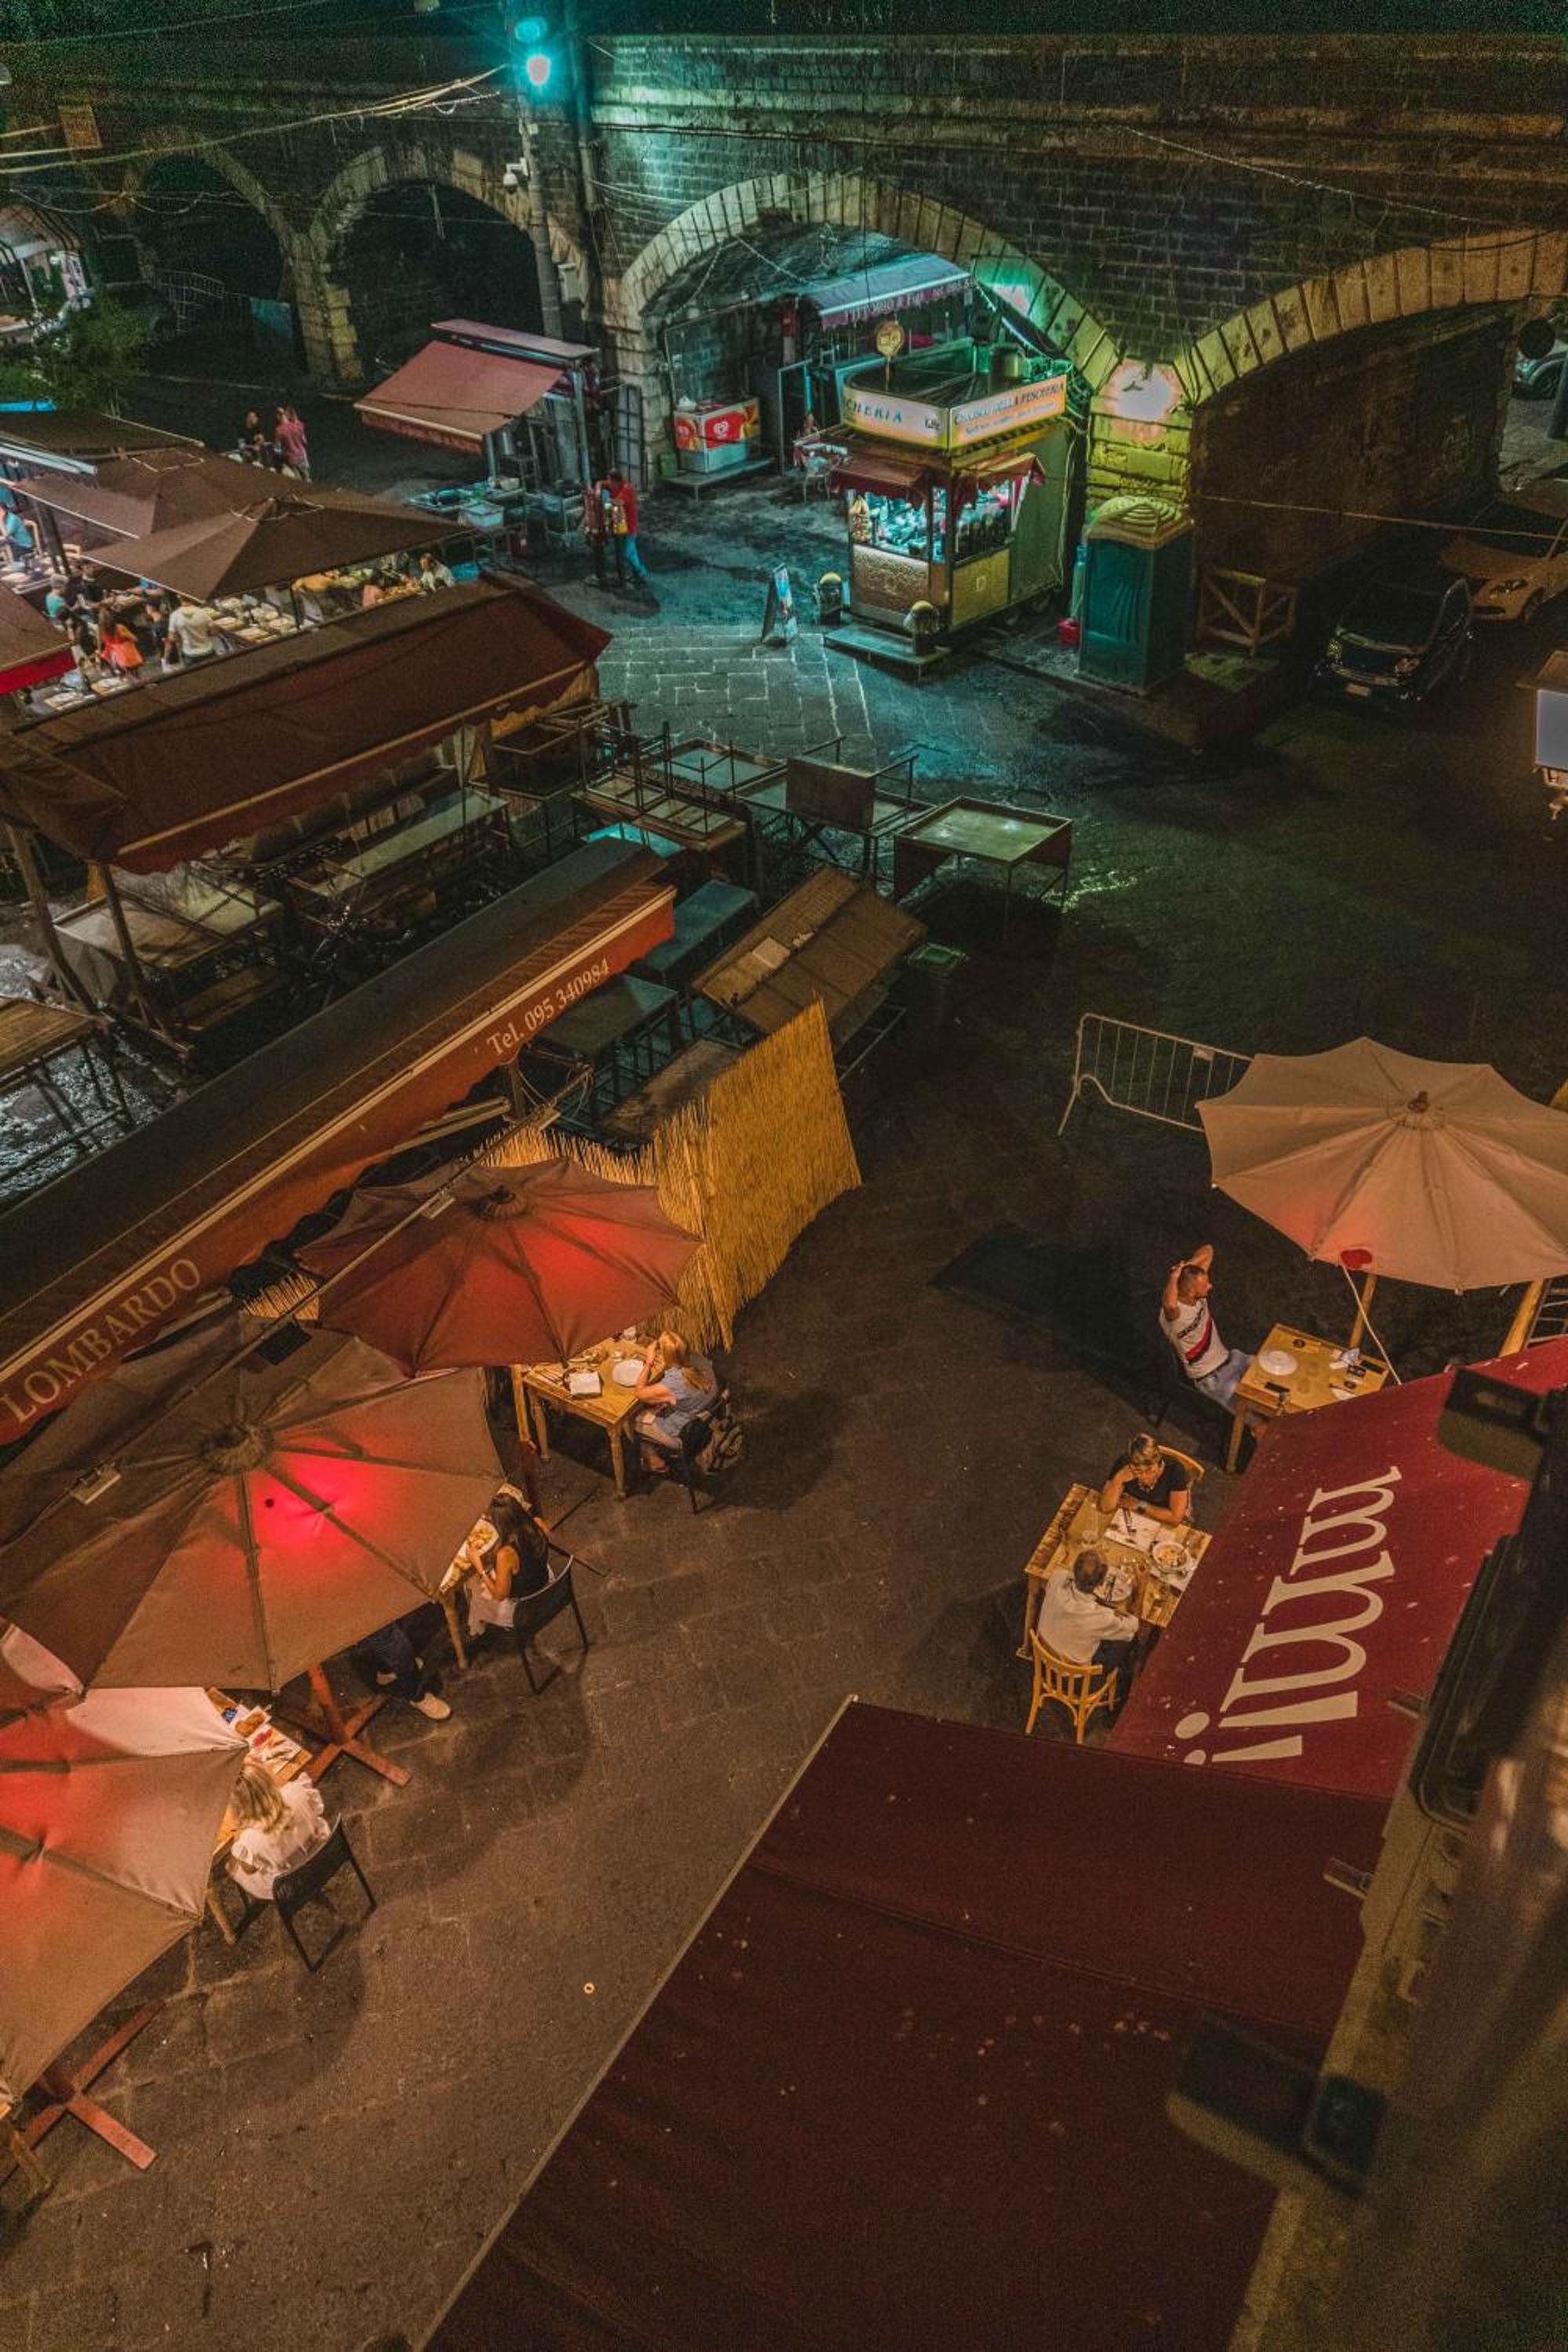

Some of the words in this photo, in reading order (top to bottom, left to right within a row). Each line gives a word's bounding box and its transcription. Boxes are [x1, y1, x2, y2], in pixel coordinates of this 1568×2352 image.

[486, 1022, 524, 1055] Tel.
[524, 998, 555, 1032] 095
[1, 1258, 201, 1423] LOMBARDO
